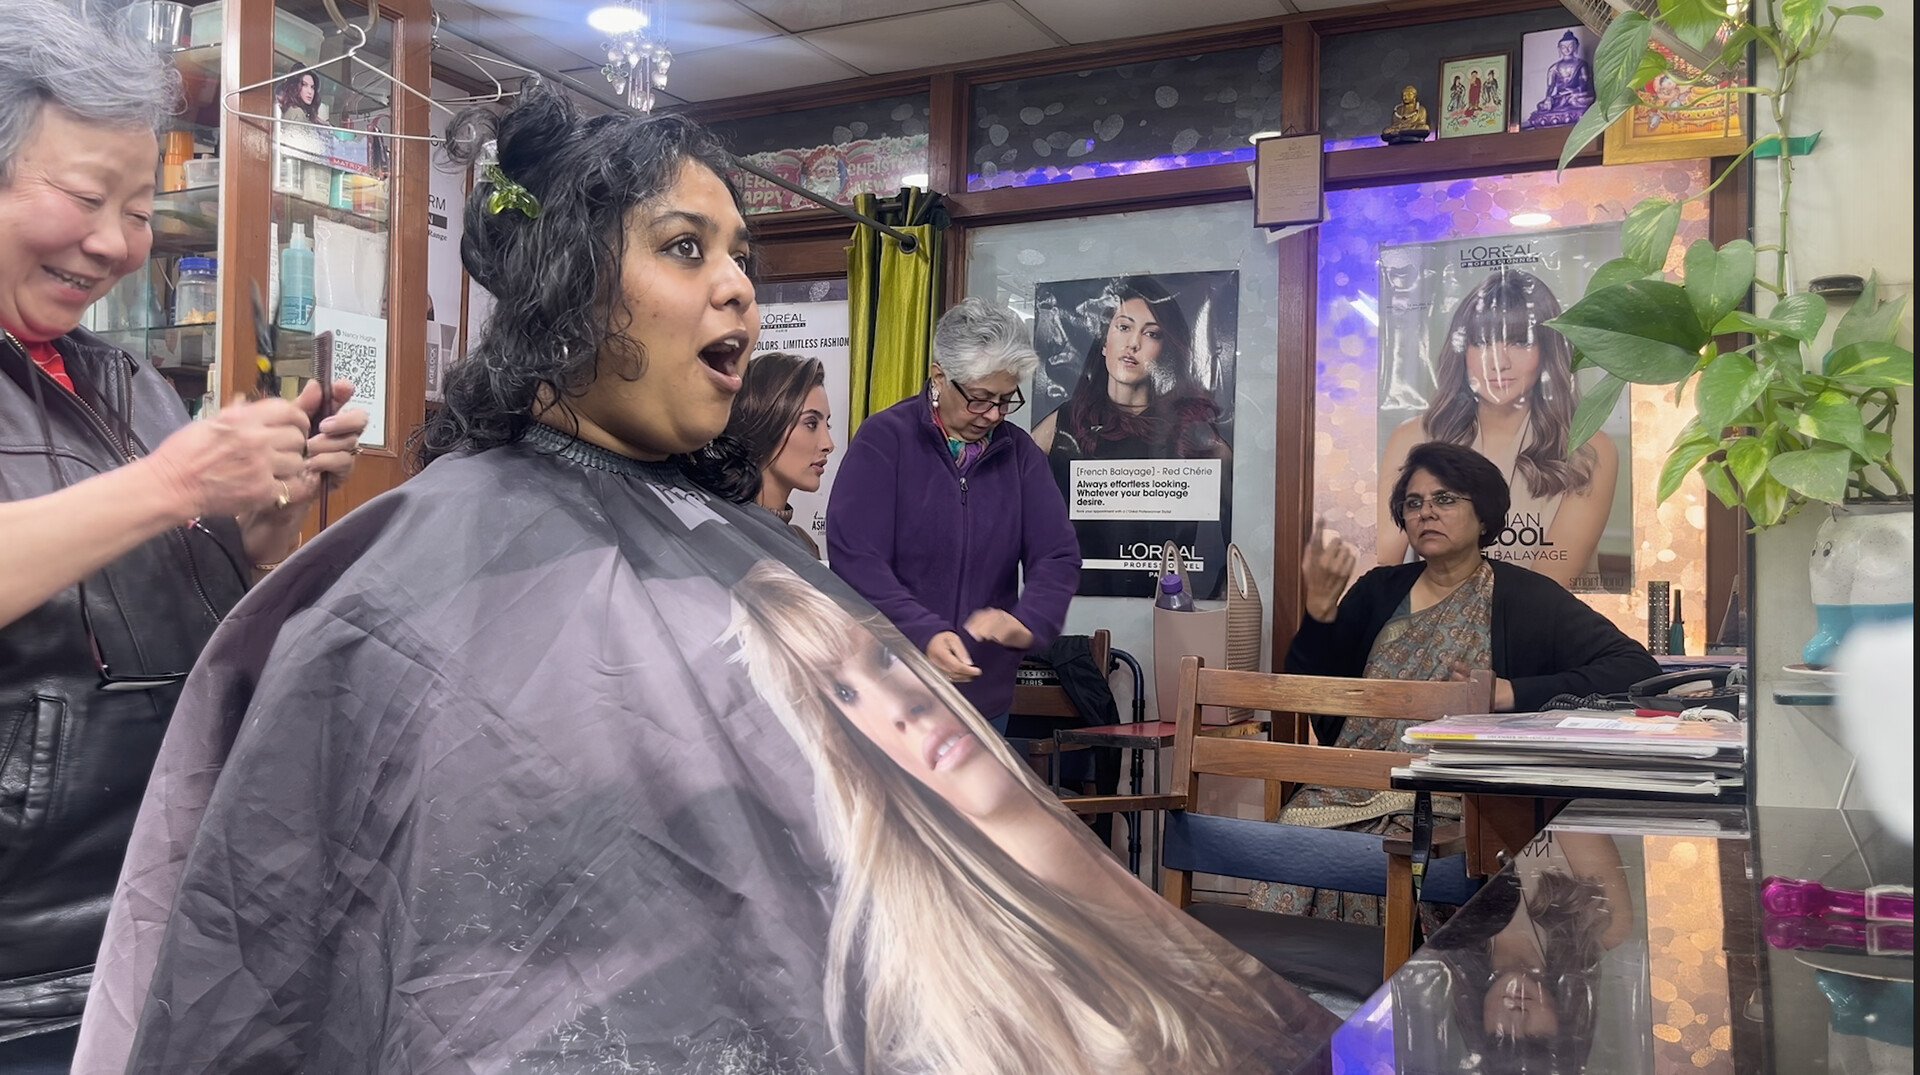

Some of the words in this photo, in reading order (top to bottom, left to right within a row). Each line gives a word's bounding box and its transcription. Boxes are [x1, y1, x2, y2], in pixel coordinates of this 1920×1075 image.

[332, 158, 364, 172] MATRIX
[742, 189, 786, 205] APPY
[783, 338, 819, 350] LIMITLESS
[820, 337, 850, 348] FASHION
[1076, 466, 1108, 477] [French
[1162, 466, 1181, 476] Red
[1182, 465, 1213, 477] Chérie
[1076, 480, 1108, 490] Always
[1110, 479, 1150, 489] effortless
[1152, 479, 1190, 490] looking.
[1076, 488, 1119, 497] Whatever
[1120, 490, 1141, 499] your
[1143, 488, 1189, 499] balayage
[1076, 498, 1105, 506] desire.
